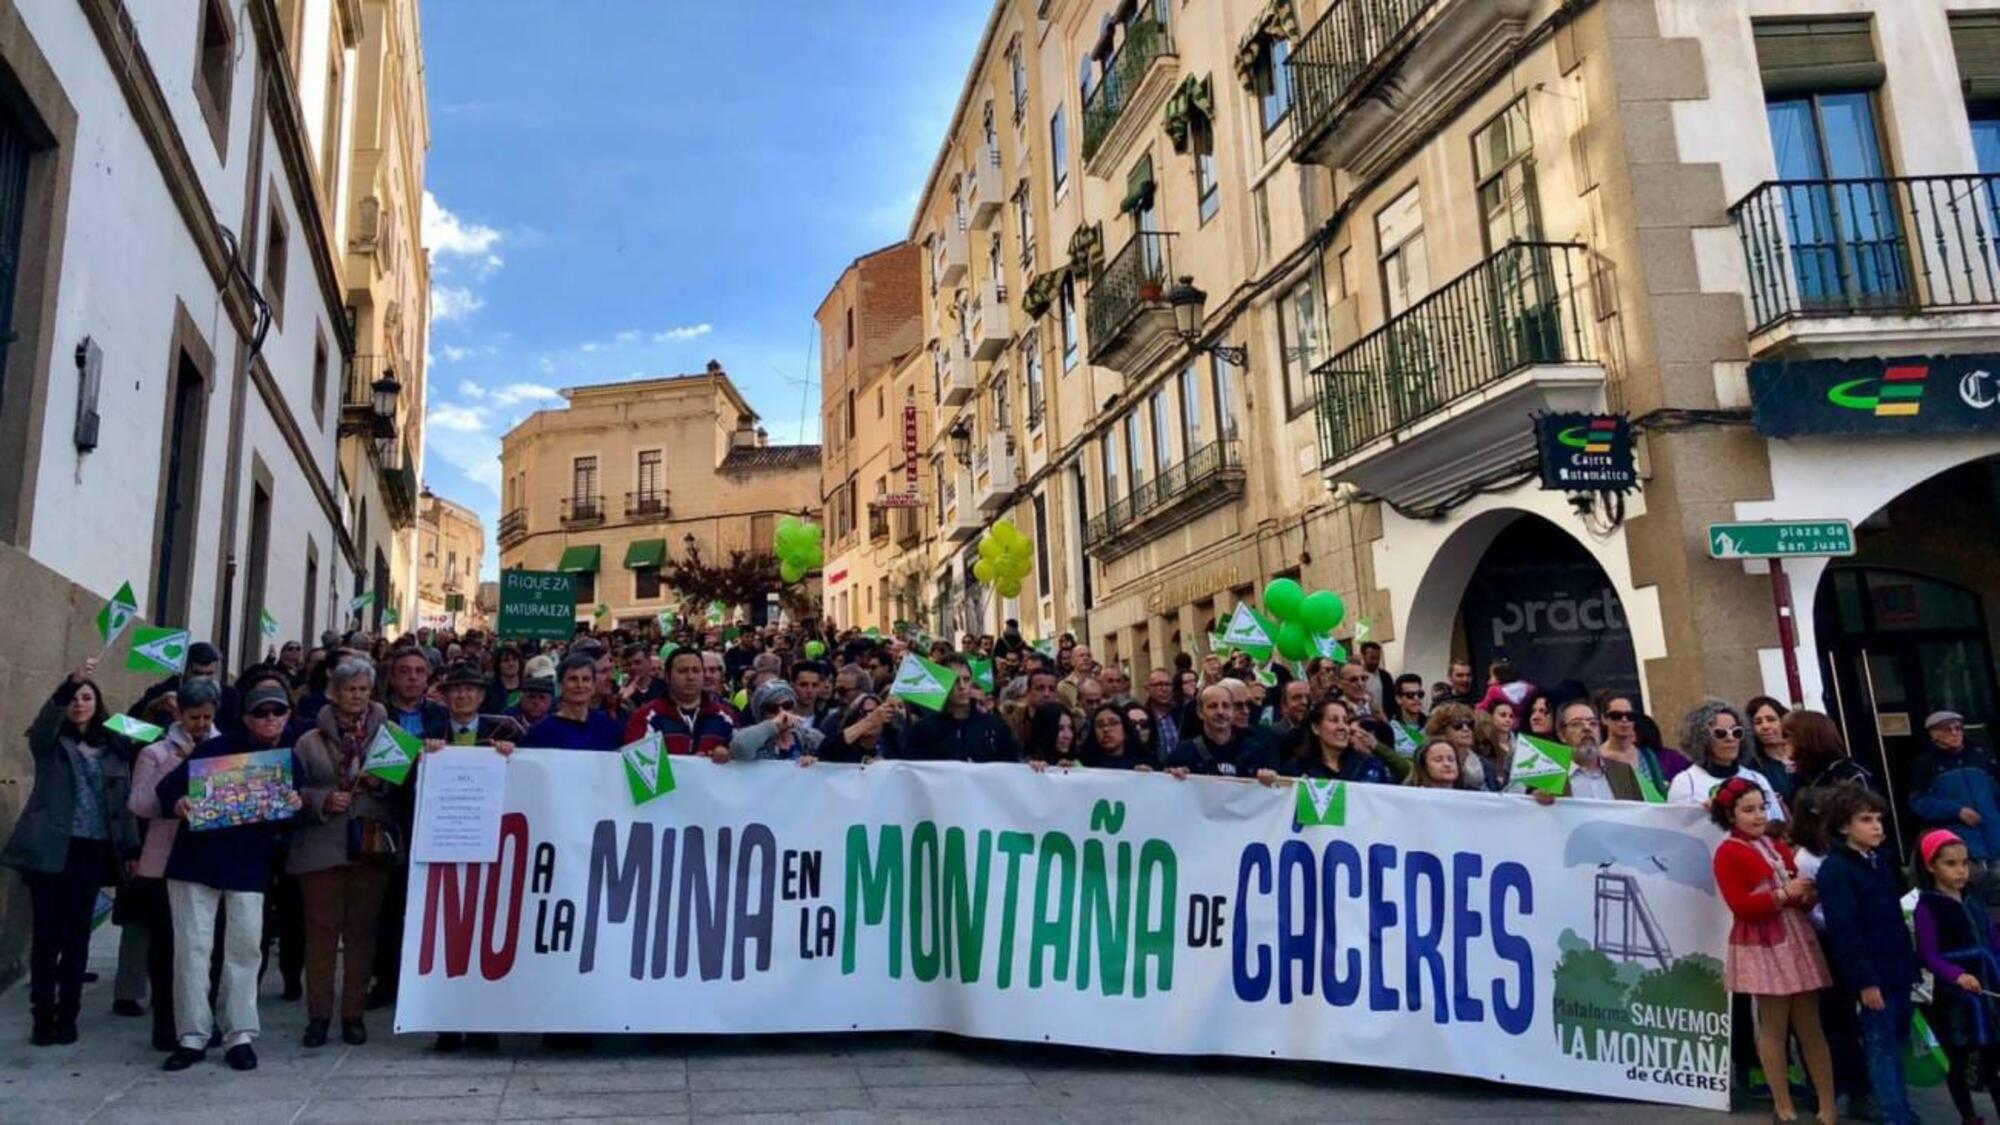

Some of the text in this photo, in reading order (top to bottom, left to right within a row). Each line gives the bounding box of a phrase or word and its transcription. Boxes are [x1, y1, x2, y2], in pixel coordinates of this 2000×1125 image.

[1571, 453, 1612, 466] Cajero
[1559, 467, 1629, 480] Automático
[1780, 526, 1844, 538] plaza de
[1777, 541, 1847, 551] San Juan
[507, 574, 569, 591] RIQUEZA
[505, 603, 570, 617] NATURALEZA
[418, 799, 1536, 1035] NO A LA MINA EN LA MONTAÑA DE CÁCERES
[1630, 1002, 1730, 1037] SALVEMOS
[1556, 1024, 1730, 1076] LA MONTAÑA
[1626, 1067, 1648, 1081] de
